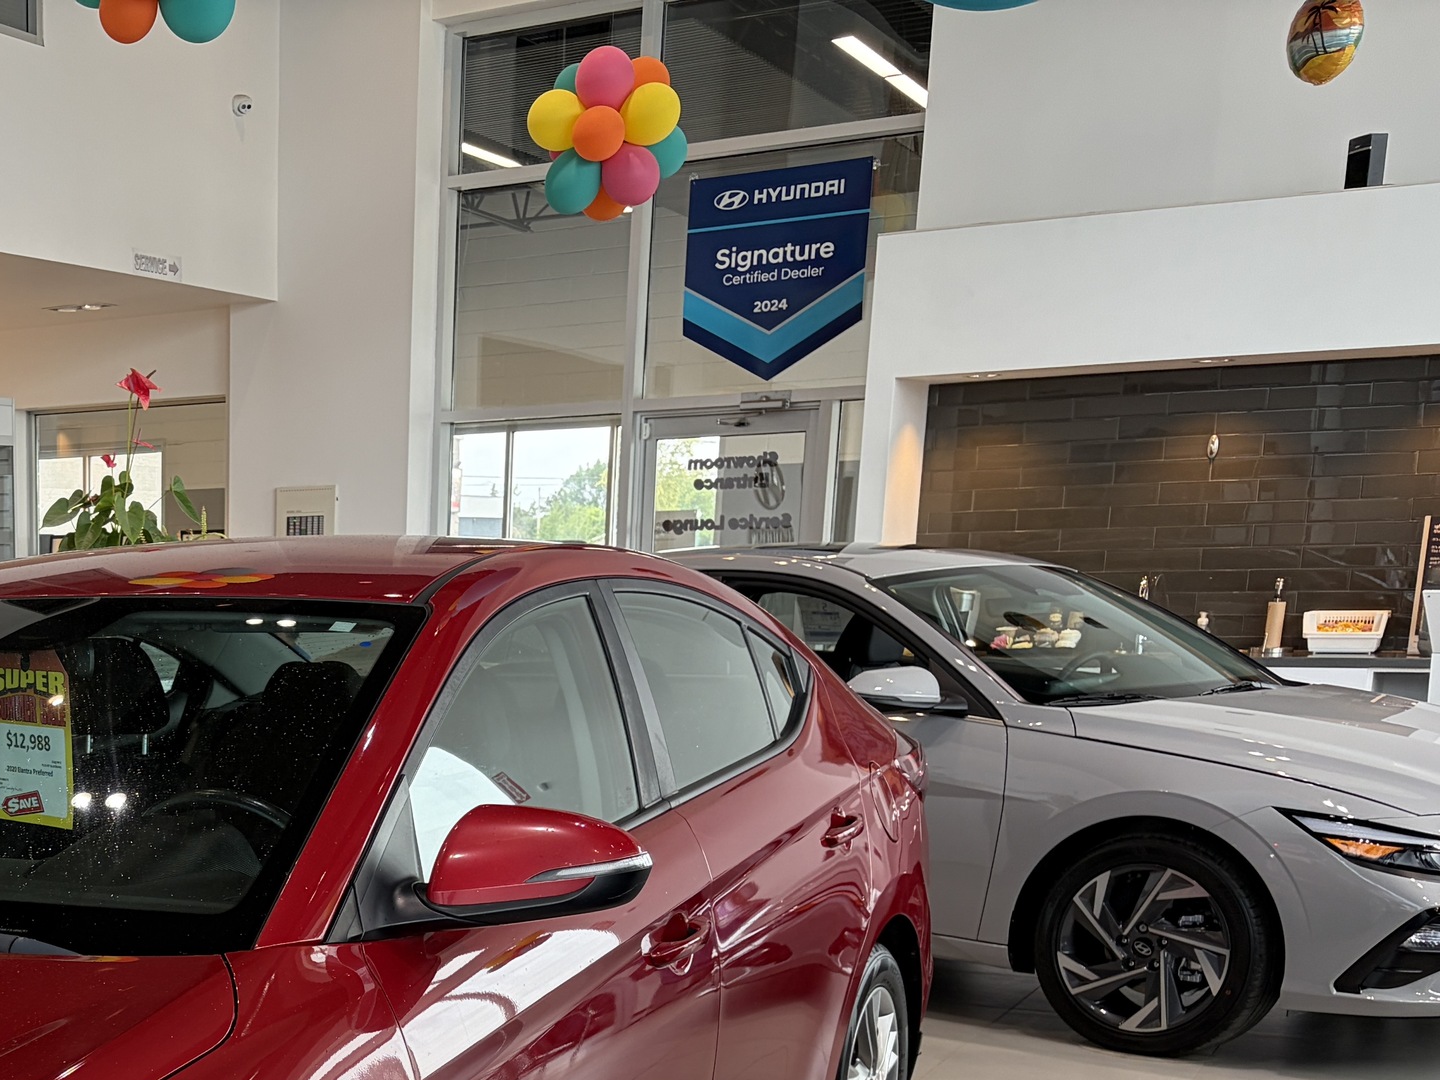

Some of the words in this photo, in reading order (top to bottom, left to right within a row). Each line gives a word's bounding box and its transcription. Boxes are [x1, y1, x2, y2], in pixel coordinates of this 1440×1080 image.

[753, 178, 846, 204] HYUNDAI
[134, 253, 167, 275] SERVICE
[715, 241, 835, 271] Signature
[722, 269, 778, 286] Certified
[781, 265, 824, 281] Dealer
[753, 298, 788, 313] 2024
[6, 730, 51, 752] $12,988
[18, 766, 33, 775] Elantra
[33, 768, 54, 778] Preferred
